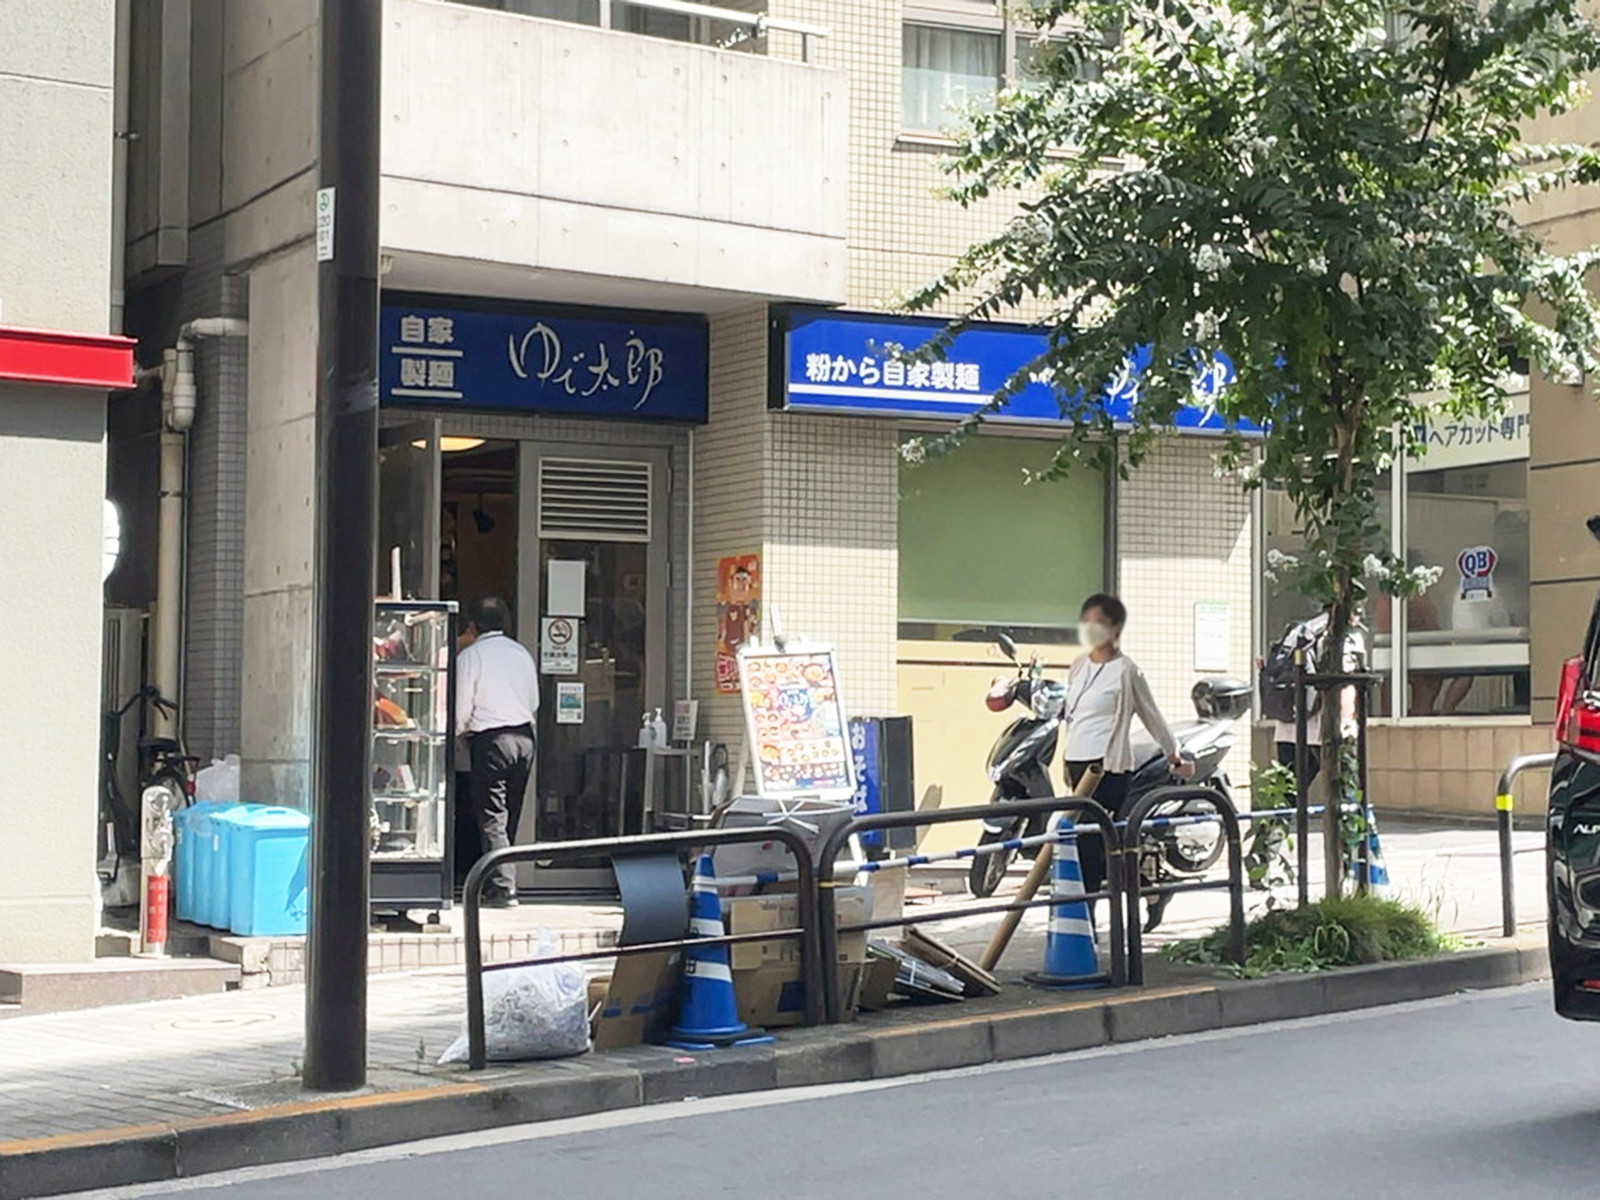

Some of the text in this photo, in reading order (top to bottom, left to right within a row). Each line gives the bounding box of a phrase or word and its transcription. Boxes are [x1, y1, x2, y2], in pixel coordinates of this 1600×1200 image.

[401, 316, 454, 344] 自家
[509, 321, 664, 411] ゆで太郎
[806, 353, 980, 391] 粉から自家製麺
[1464, 551, 1488, 575] QB
